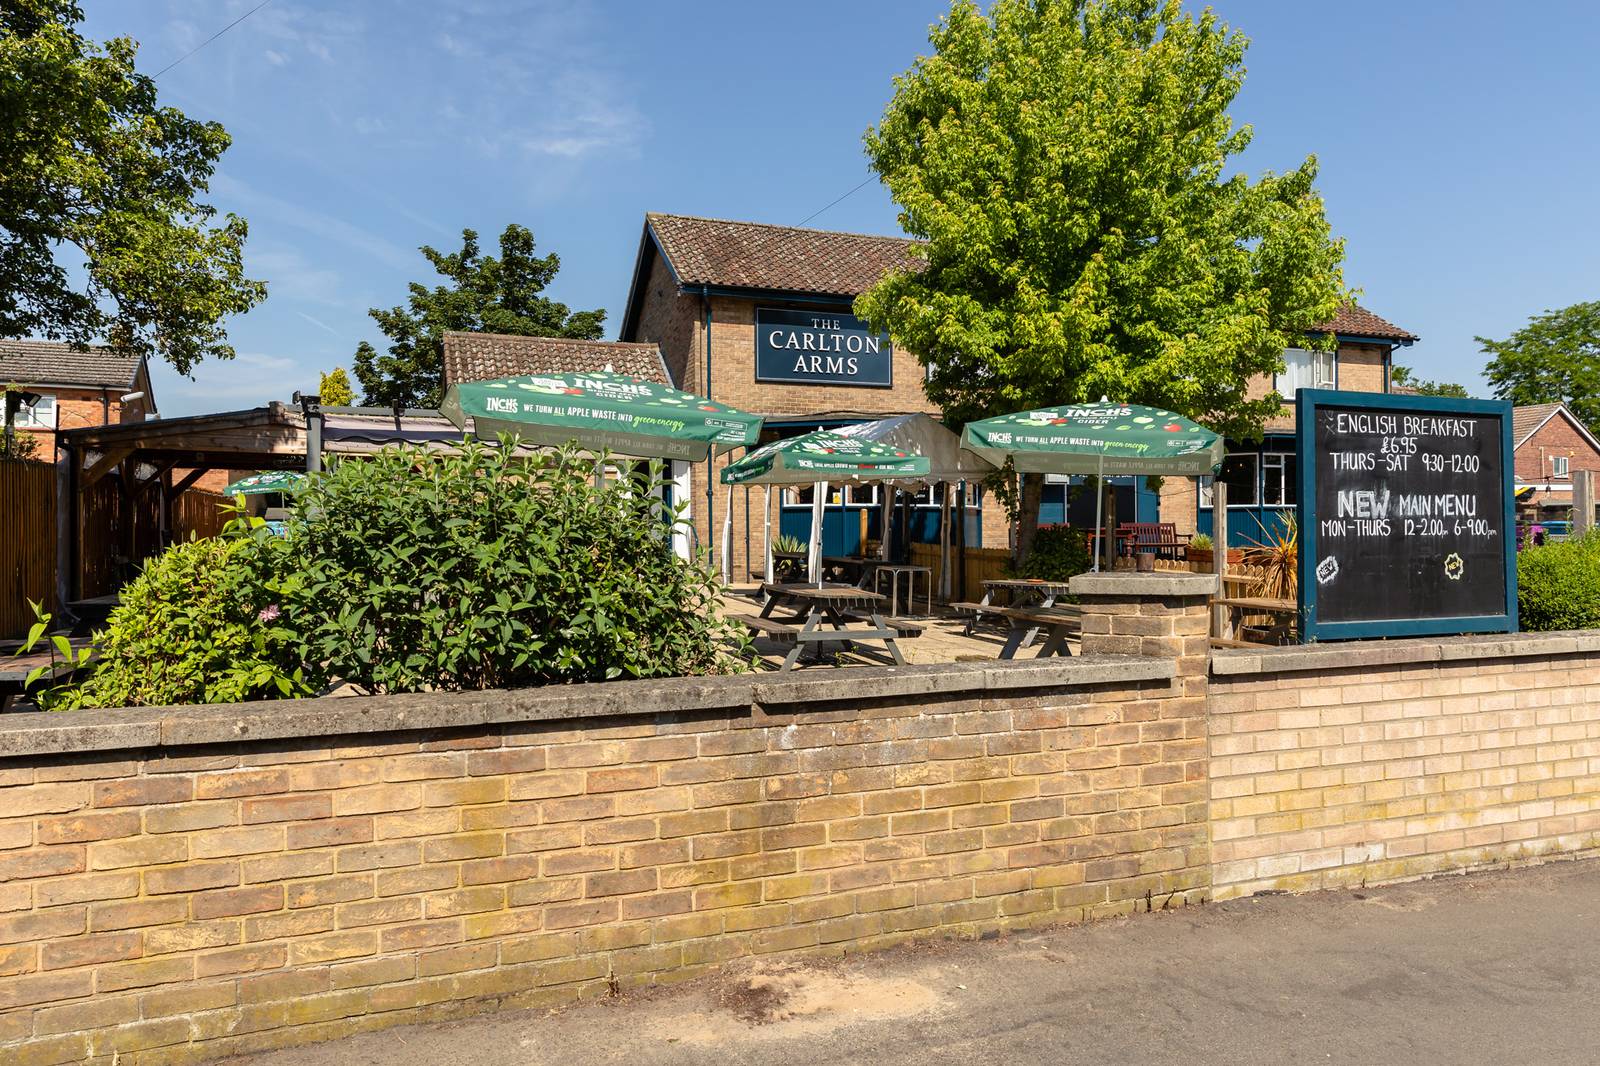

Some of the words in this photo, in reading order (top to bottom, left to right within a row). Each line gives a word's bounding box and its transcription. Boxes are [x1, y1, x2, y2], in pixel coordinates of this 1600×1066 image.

[811, 318, 841, 330] THE
[769, 330, 880, 354] CARLTON
[793, 354, 858, 375] ARMS
[523, 404, 534, 412] WE
[535, 404, 553, 414] TURN
[553, 406, 565, 416] ALL
[567, 406, 591, 418] APPLE
[592, 408, 617, 421] WASTE
[617, 412, 634, 422] INTO
[1337, 414, 1397, 435] ENGLISH
[1404, 416, 1477, 437] BREAKFAST
[1049, 436, 1068, 445] APPLE
[1069, 437, 1090, 446] WASTE
[1091, 439, 1104, 447] INTO
[1381, 437, 1418, 454] £6.95
[1337, 489, 1391, 518] NEW
[1399, 494, 1431, 516] MAIN
[1435, 495, 1477, 517] MENU
[1448, 560, 1461, 571] NEW
